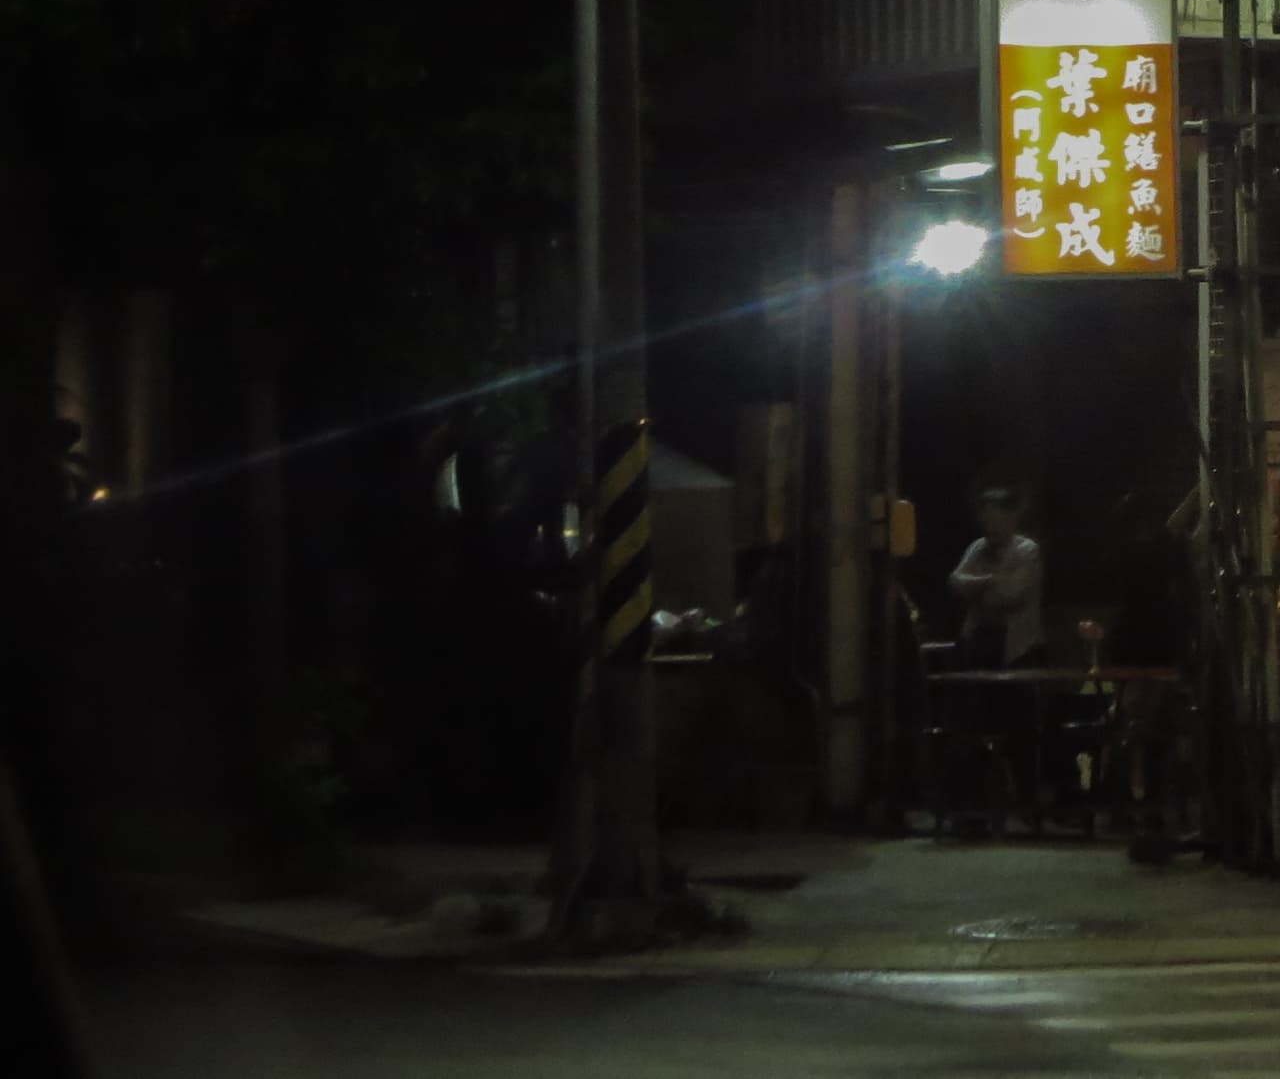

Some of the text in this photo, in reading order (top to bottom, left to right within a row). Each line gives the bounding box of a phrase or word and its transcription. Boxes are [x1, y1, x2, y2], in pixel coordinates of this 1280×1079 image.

[1046, 48, 1115, 265] 葉傑成
[1122, 54, 1165, 261] 廟口鱔魚麵
